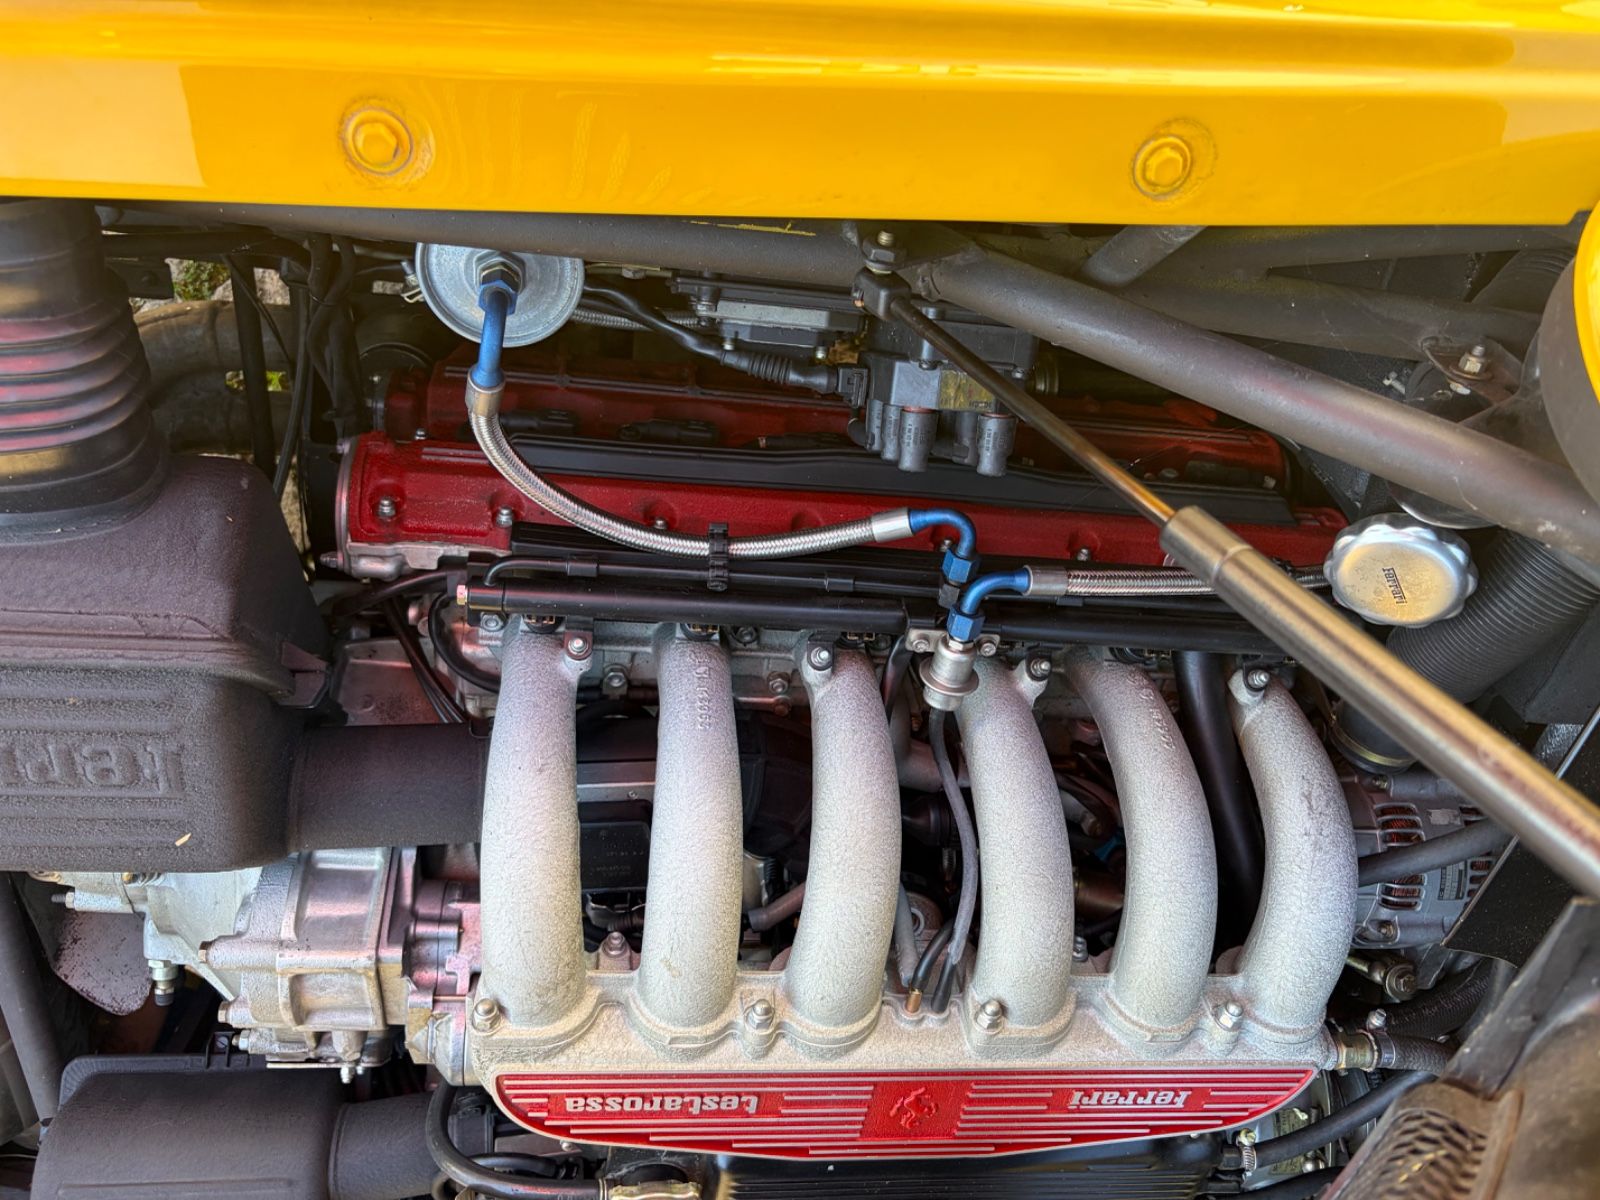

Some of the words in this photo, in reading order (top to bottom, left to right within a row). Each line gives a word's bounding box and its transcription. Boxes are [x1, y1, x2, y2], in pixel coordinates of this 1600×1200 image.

[1382, 566, 1407, 604] Ferrari
[565, 1095, 759, 1115] testarossa
[1067, 1090, 1192, 1109] Ferrari
